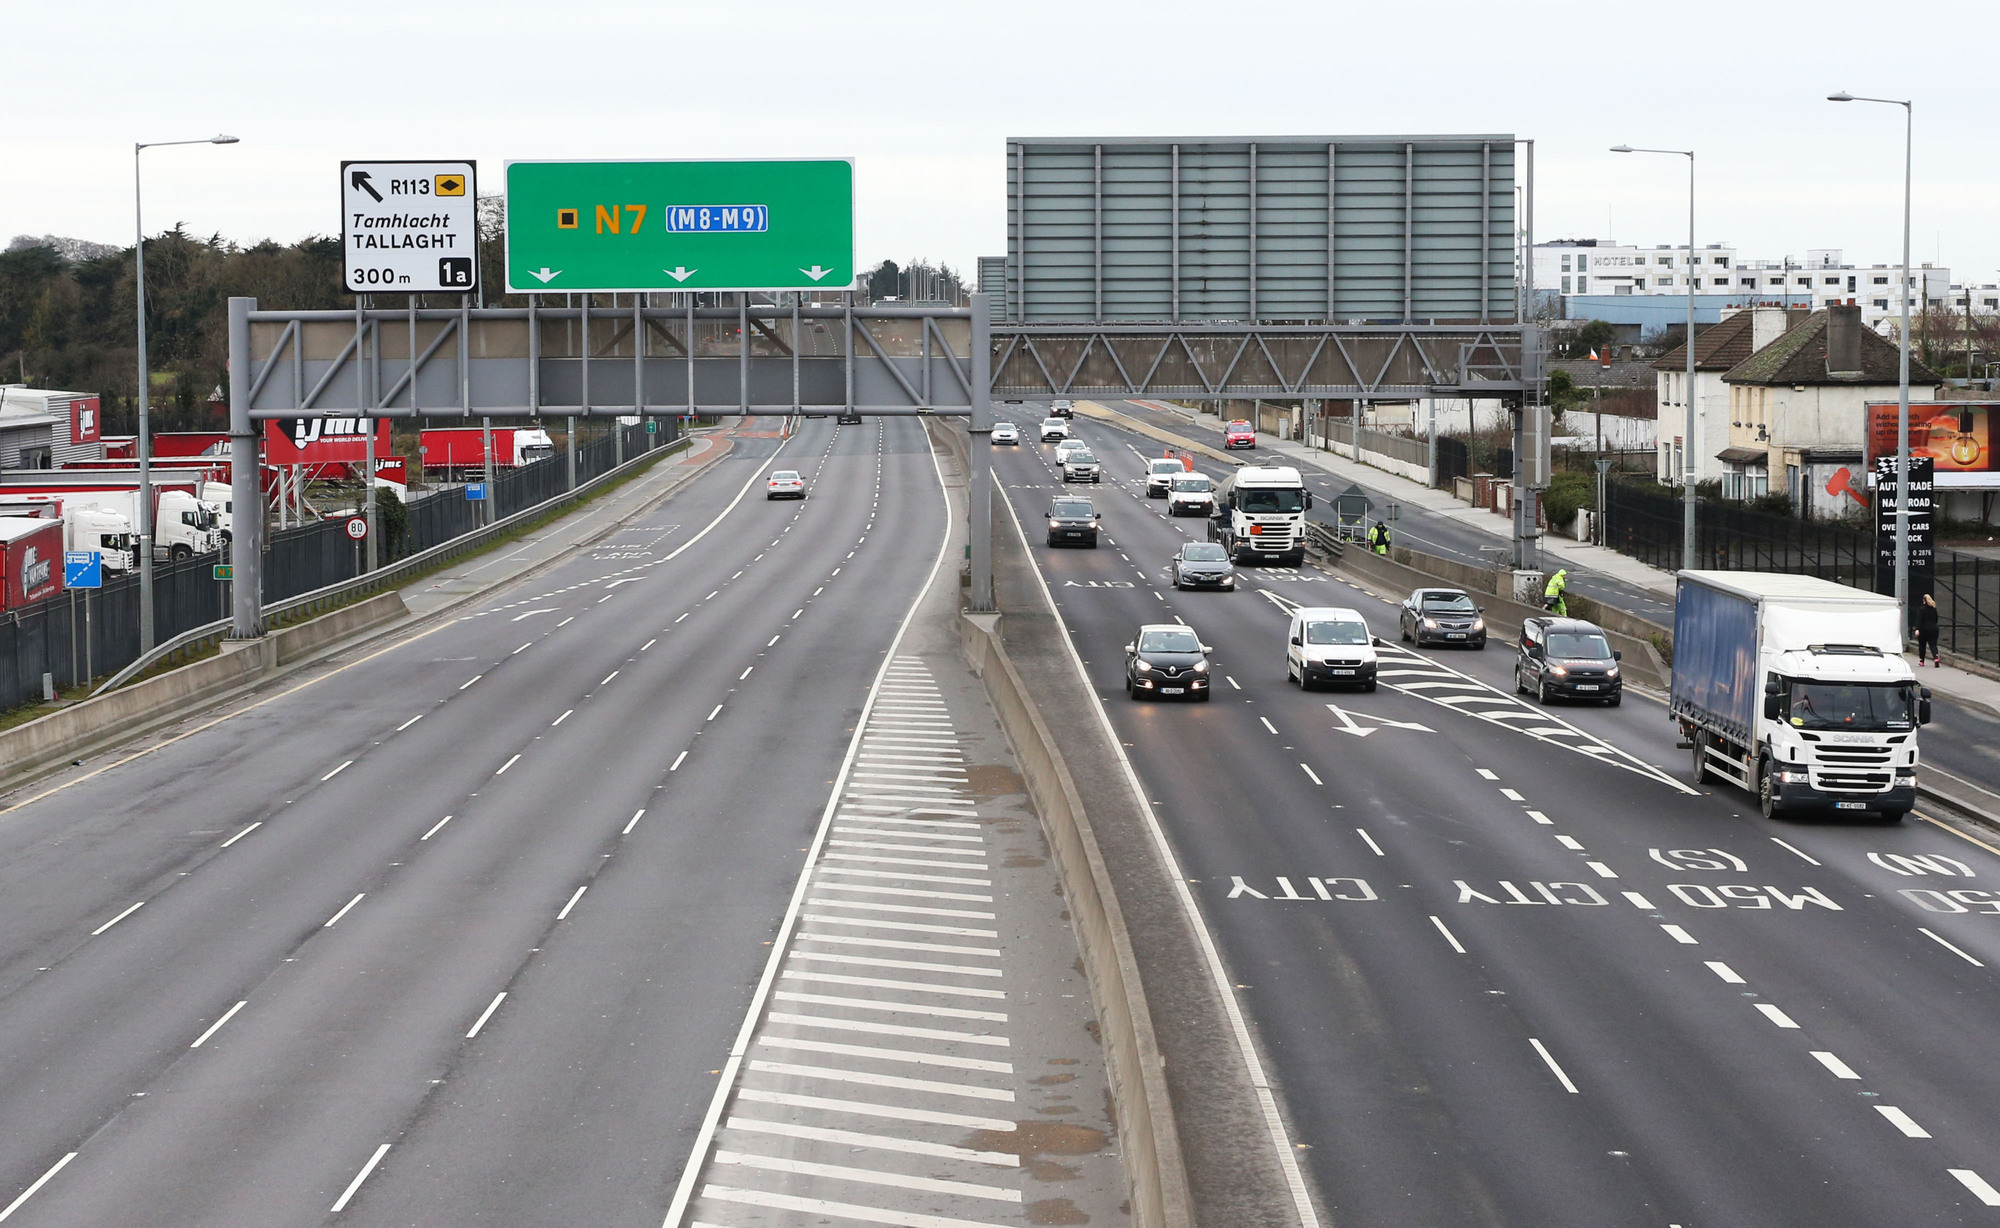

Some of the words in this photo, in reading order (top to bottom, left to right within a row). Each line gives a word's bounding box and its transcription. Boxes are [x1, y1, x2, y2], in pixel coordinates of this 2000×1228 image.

[391, 179, 430, 195] R113
[353, 213, 450, 228] Tamhlacht
[595, 204, 648, 235] N7
[670, 206, 764, 231] (M8-M9)
[353, 234, 456, 249] TALLAGHT
[1594, 256, 1634, 266] HOTEL
[353, 268, 395, 284] 300
[399, 275, 411, 284] m
[443, 262, 467, 283] 1a
[378, 459, 402, 470] jmc
[1879, 482, 1898, 491] AUT
[1882, 499, 1898, 507] NAA
[1908, 498, 1930, 507] ROAD
[351, 523, 362, 532] 80
[1064, 580, 1135, 588] CITY
[1254, 575, 1328, 584] M50
[1833, 735, 1875, 743] SCANIA
[1648, 848, 1747, 873] (S)
[1867, 852, 1976, 877] (N)
[1227, 876, 1378, 901] CITY
[1453, 881, 1610, 907] CITY
[1667, 884, 1844, 912] M50
[1897, 889, 2000, 915] 50
